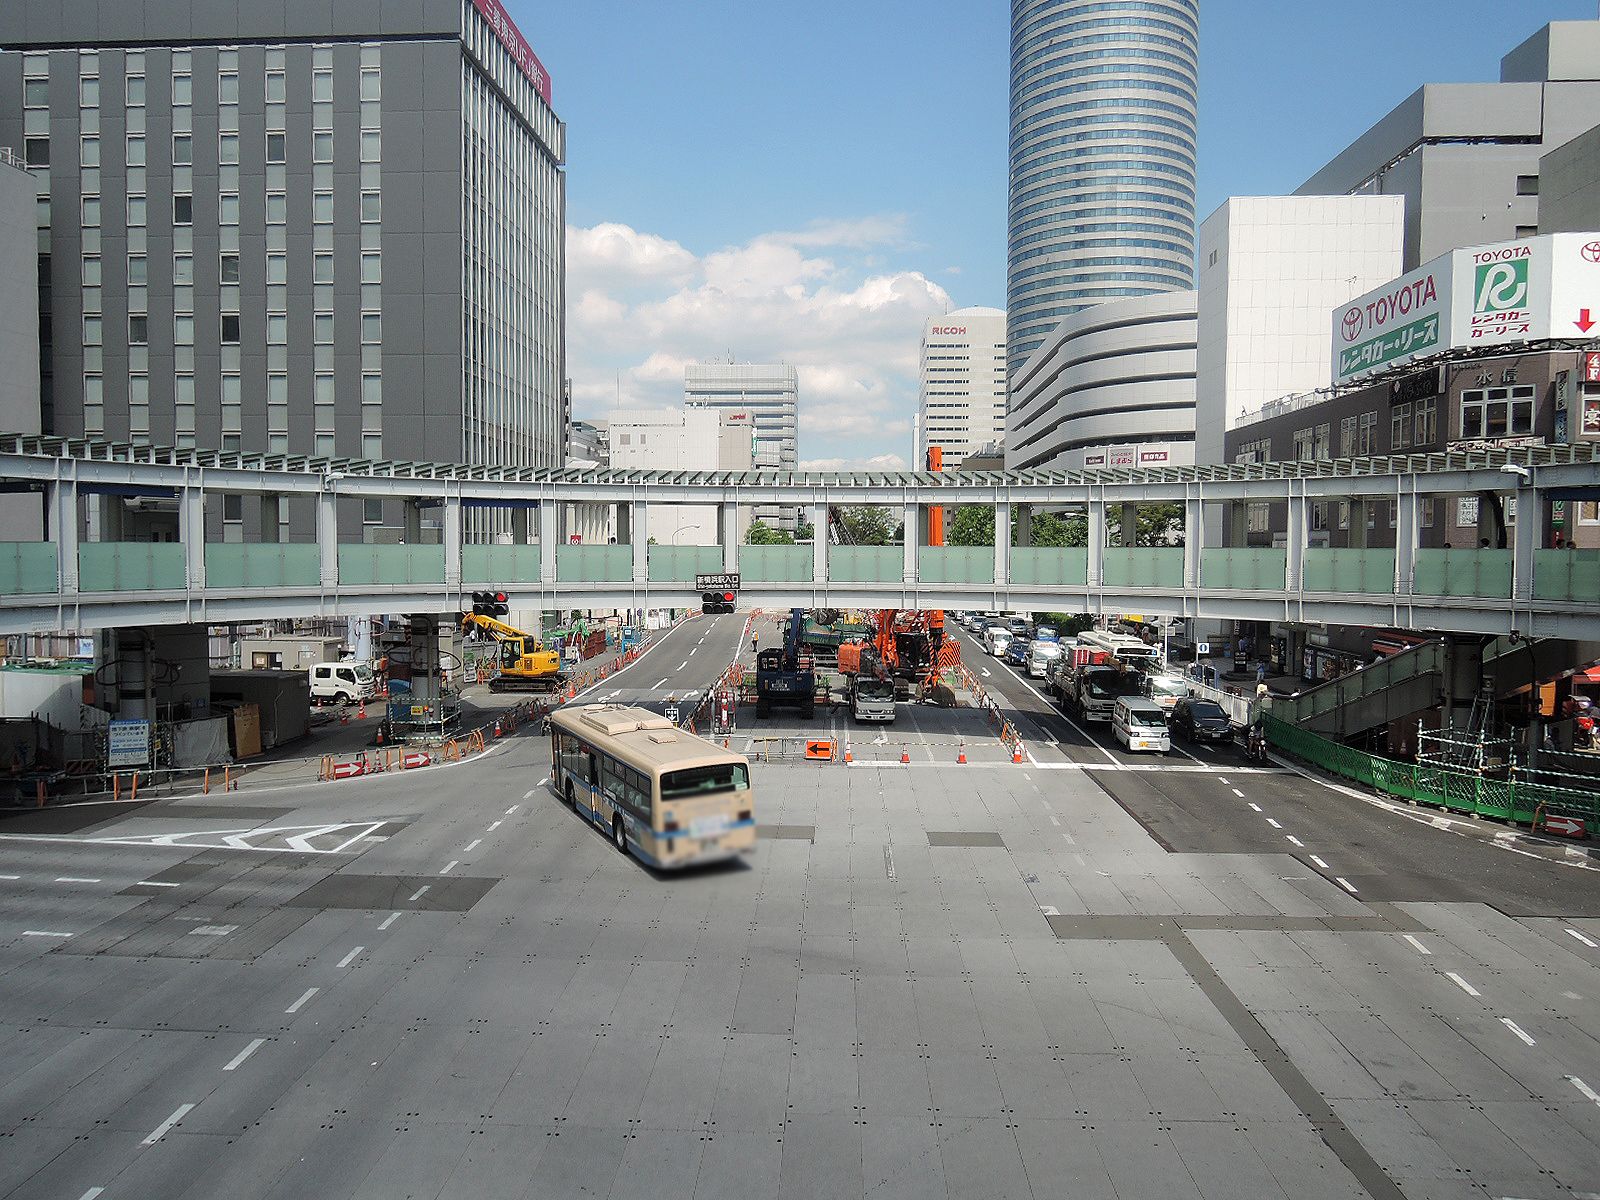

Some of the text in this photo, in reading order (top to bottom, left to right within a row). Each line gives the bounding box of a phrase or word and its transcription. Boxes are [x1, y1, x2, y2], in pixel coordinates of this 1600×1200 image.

[1473, 246, 1531, 263] TOYOTA
[1366, 275, 1436, 329] TOYOTA
[1471, 311, 1530, 324] レンタカー
[932, 327, 966, 335] RICOH
[1471, 324, 1529, 338] カーリース
[1341, 319, 1436, 373] レンタカー・リース
